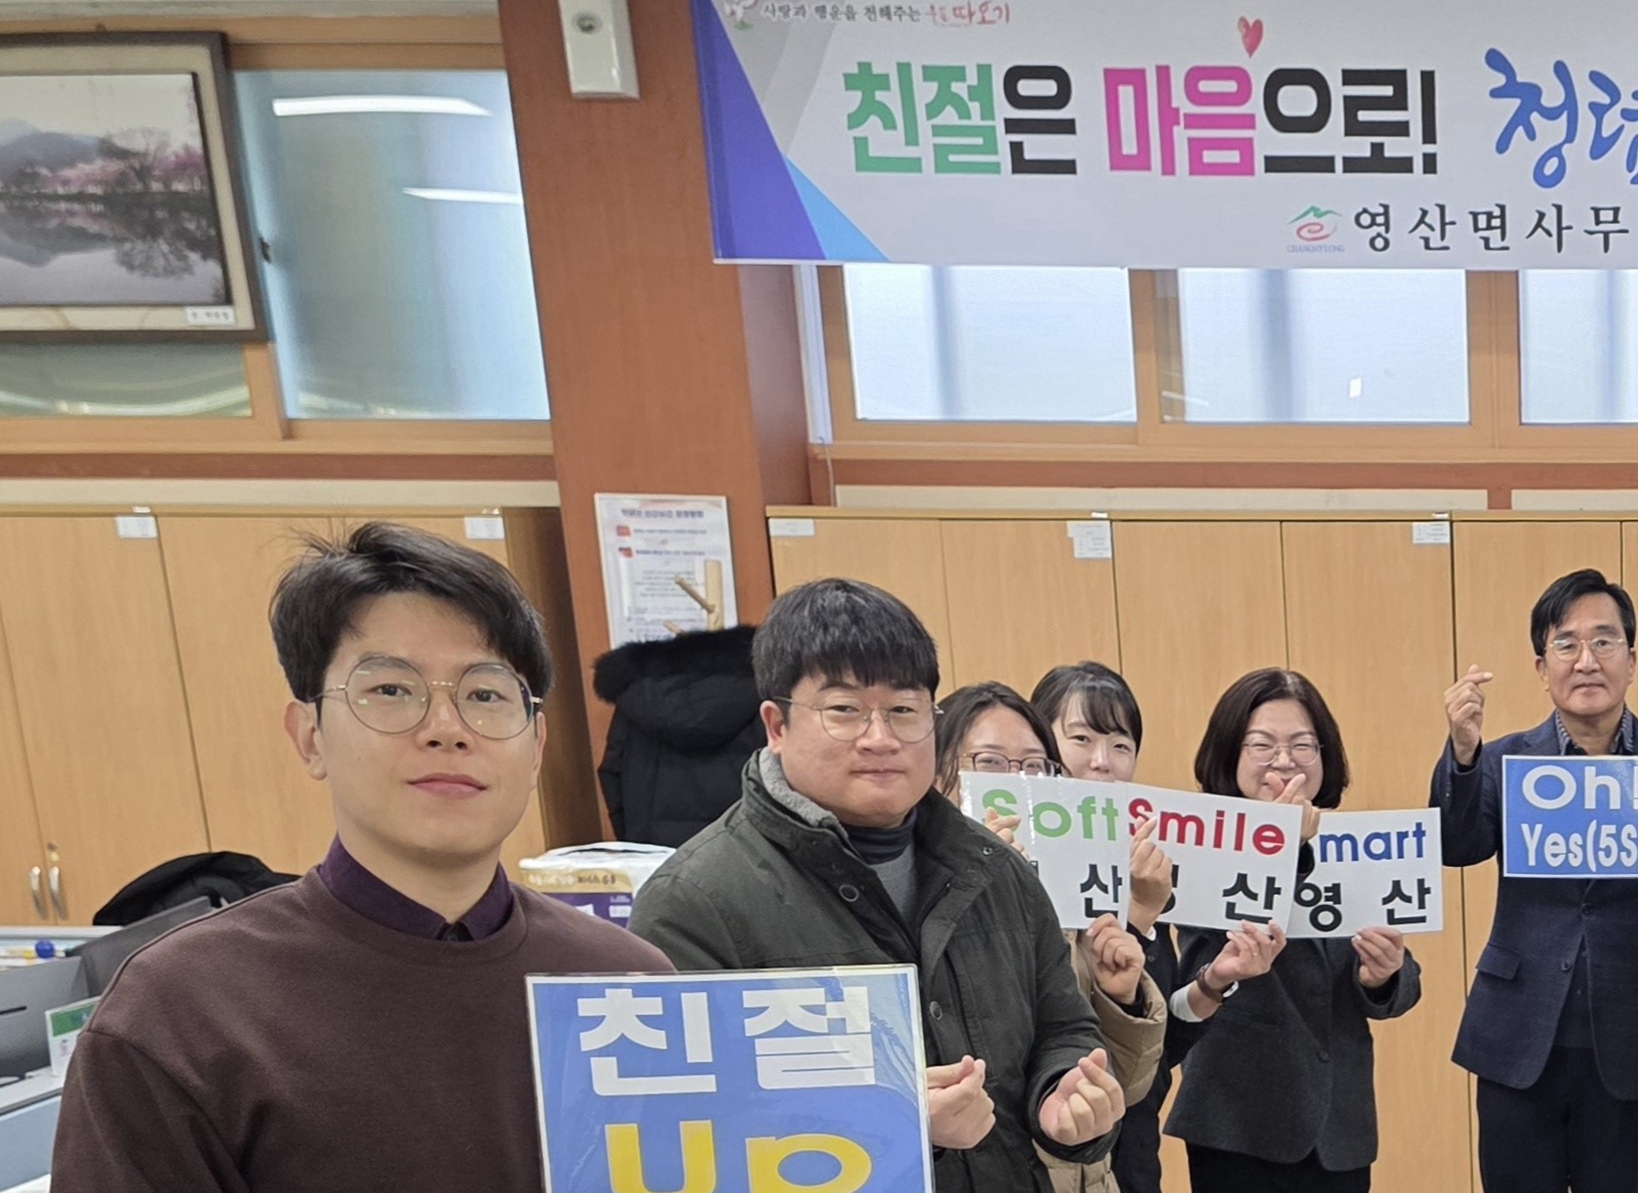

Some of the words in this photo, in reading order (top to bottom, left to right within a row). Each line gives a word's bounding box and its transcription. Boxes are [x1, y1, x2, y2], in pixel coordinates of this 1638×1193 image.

[842, 61, 1077, 175] 친절은
[1102, 64, 1437, 176] 마음으로!
[982, 788, 1120, 841] Soft
[1128, 798, 1285, 855] Smile
[1319, 822, 1426, 862] mart
[577, 986, 876, 1096] 친절
